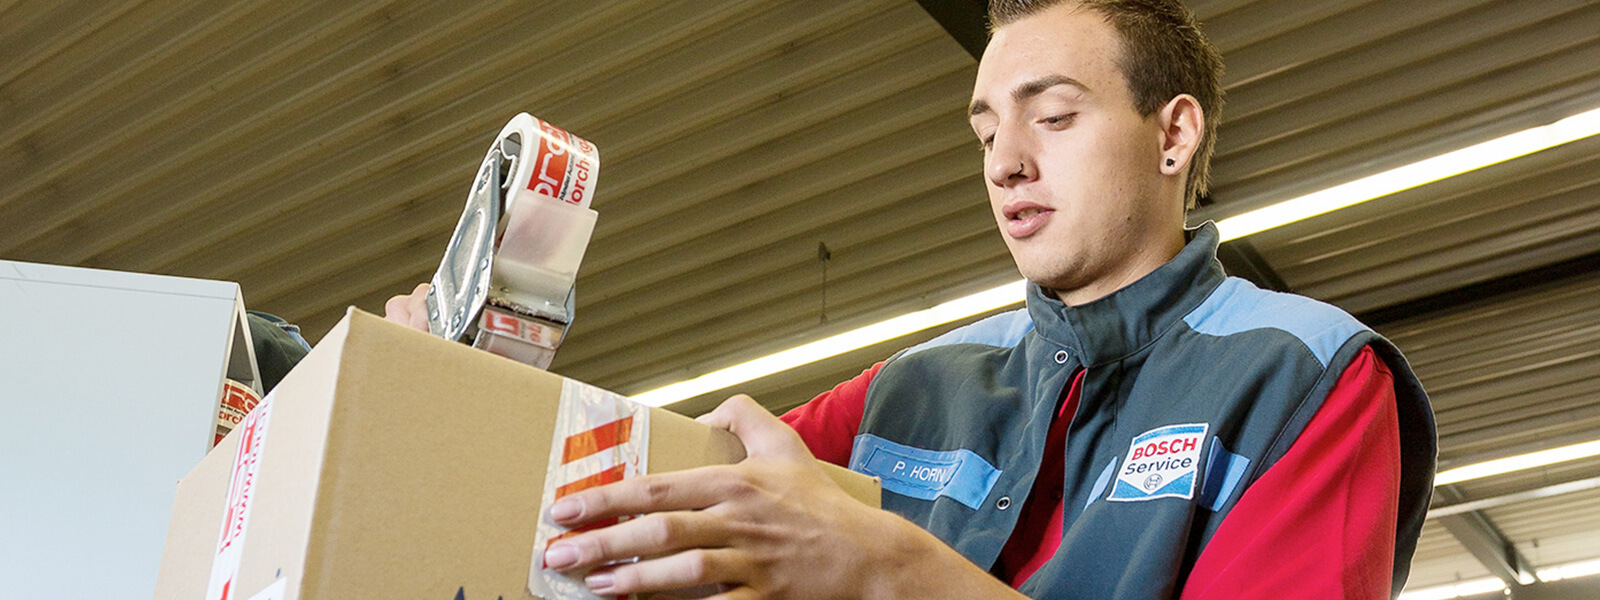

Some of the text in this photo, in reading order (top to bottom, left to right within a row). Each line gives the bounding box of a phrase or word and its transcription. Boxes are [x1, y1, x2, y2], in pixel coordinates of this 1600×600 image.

[1131, 437, 1198, 461] BOSCH
[892, 460, 947, 483] P. HORN
[1125, 456, 1193, 476] Service
